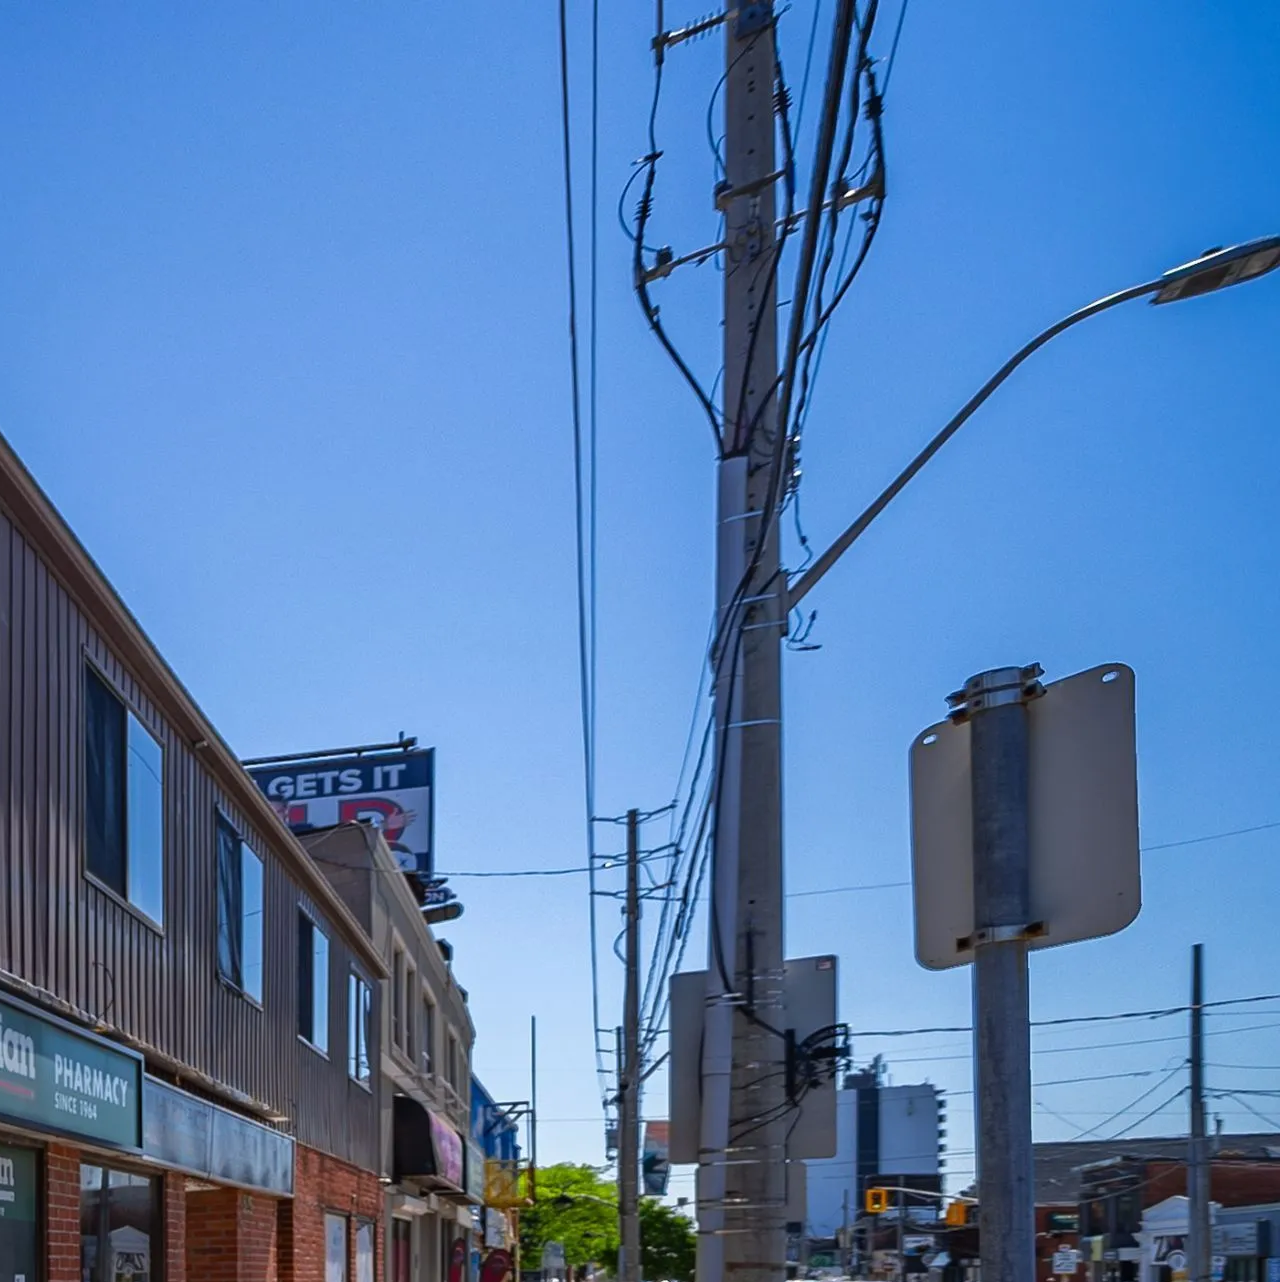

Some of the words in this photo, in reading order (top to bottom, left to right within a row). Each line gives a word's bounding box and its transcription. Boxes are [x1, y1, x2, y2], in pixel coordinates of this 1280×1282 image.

[268, 769, 362, 799] GETS
[373, 764, 407, 789] IT
[54, 1054, 129, 1108] PHARMACY
[54, 1091, 77, 1115] SINCE
[78, 1096, 98, 1121] 1964
